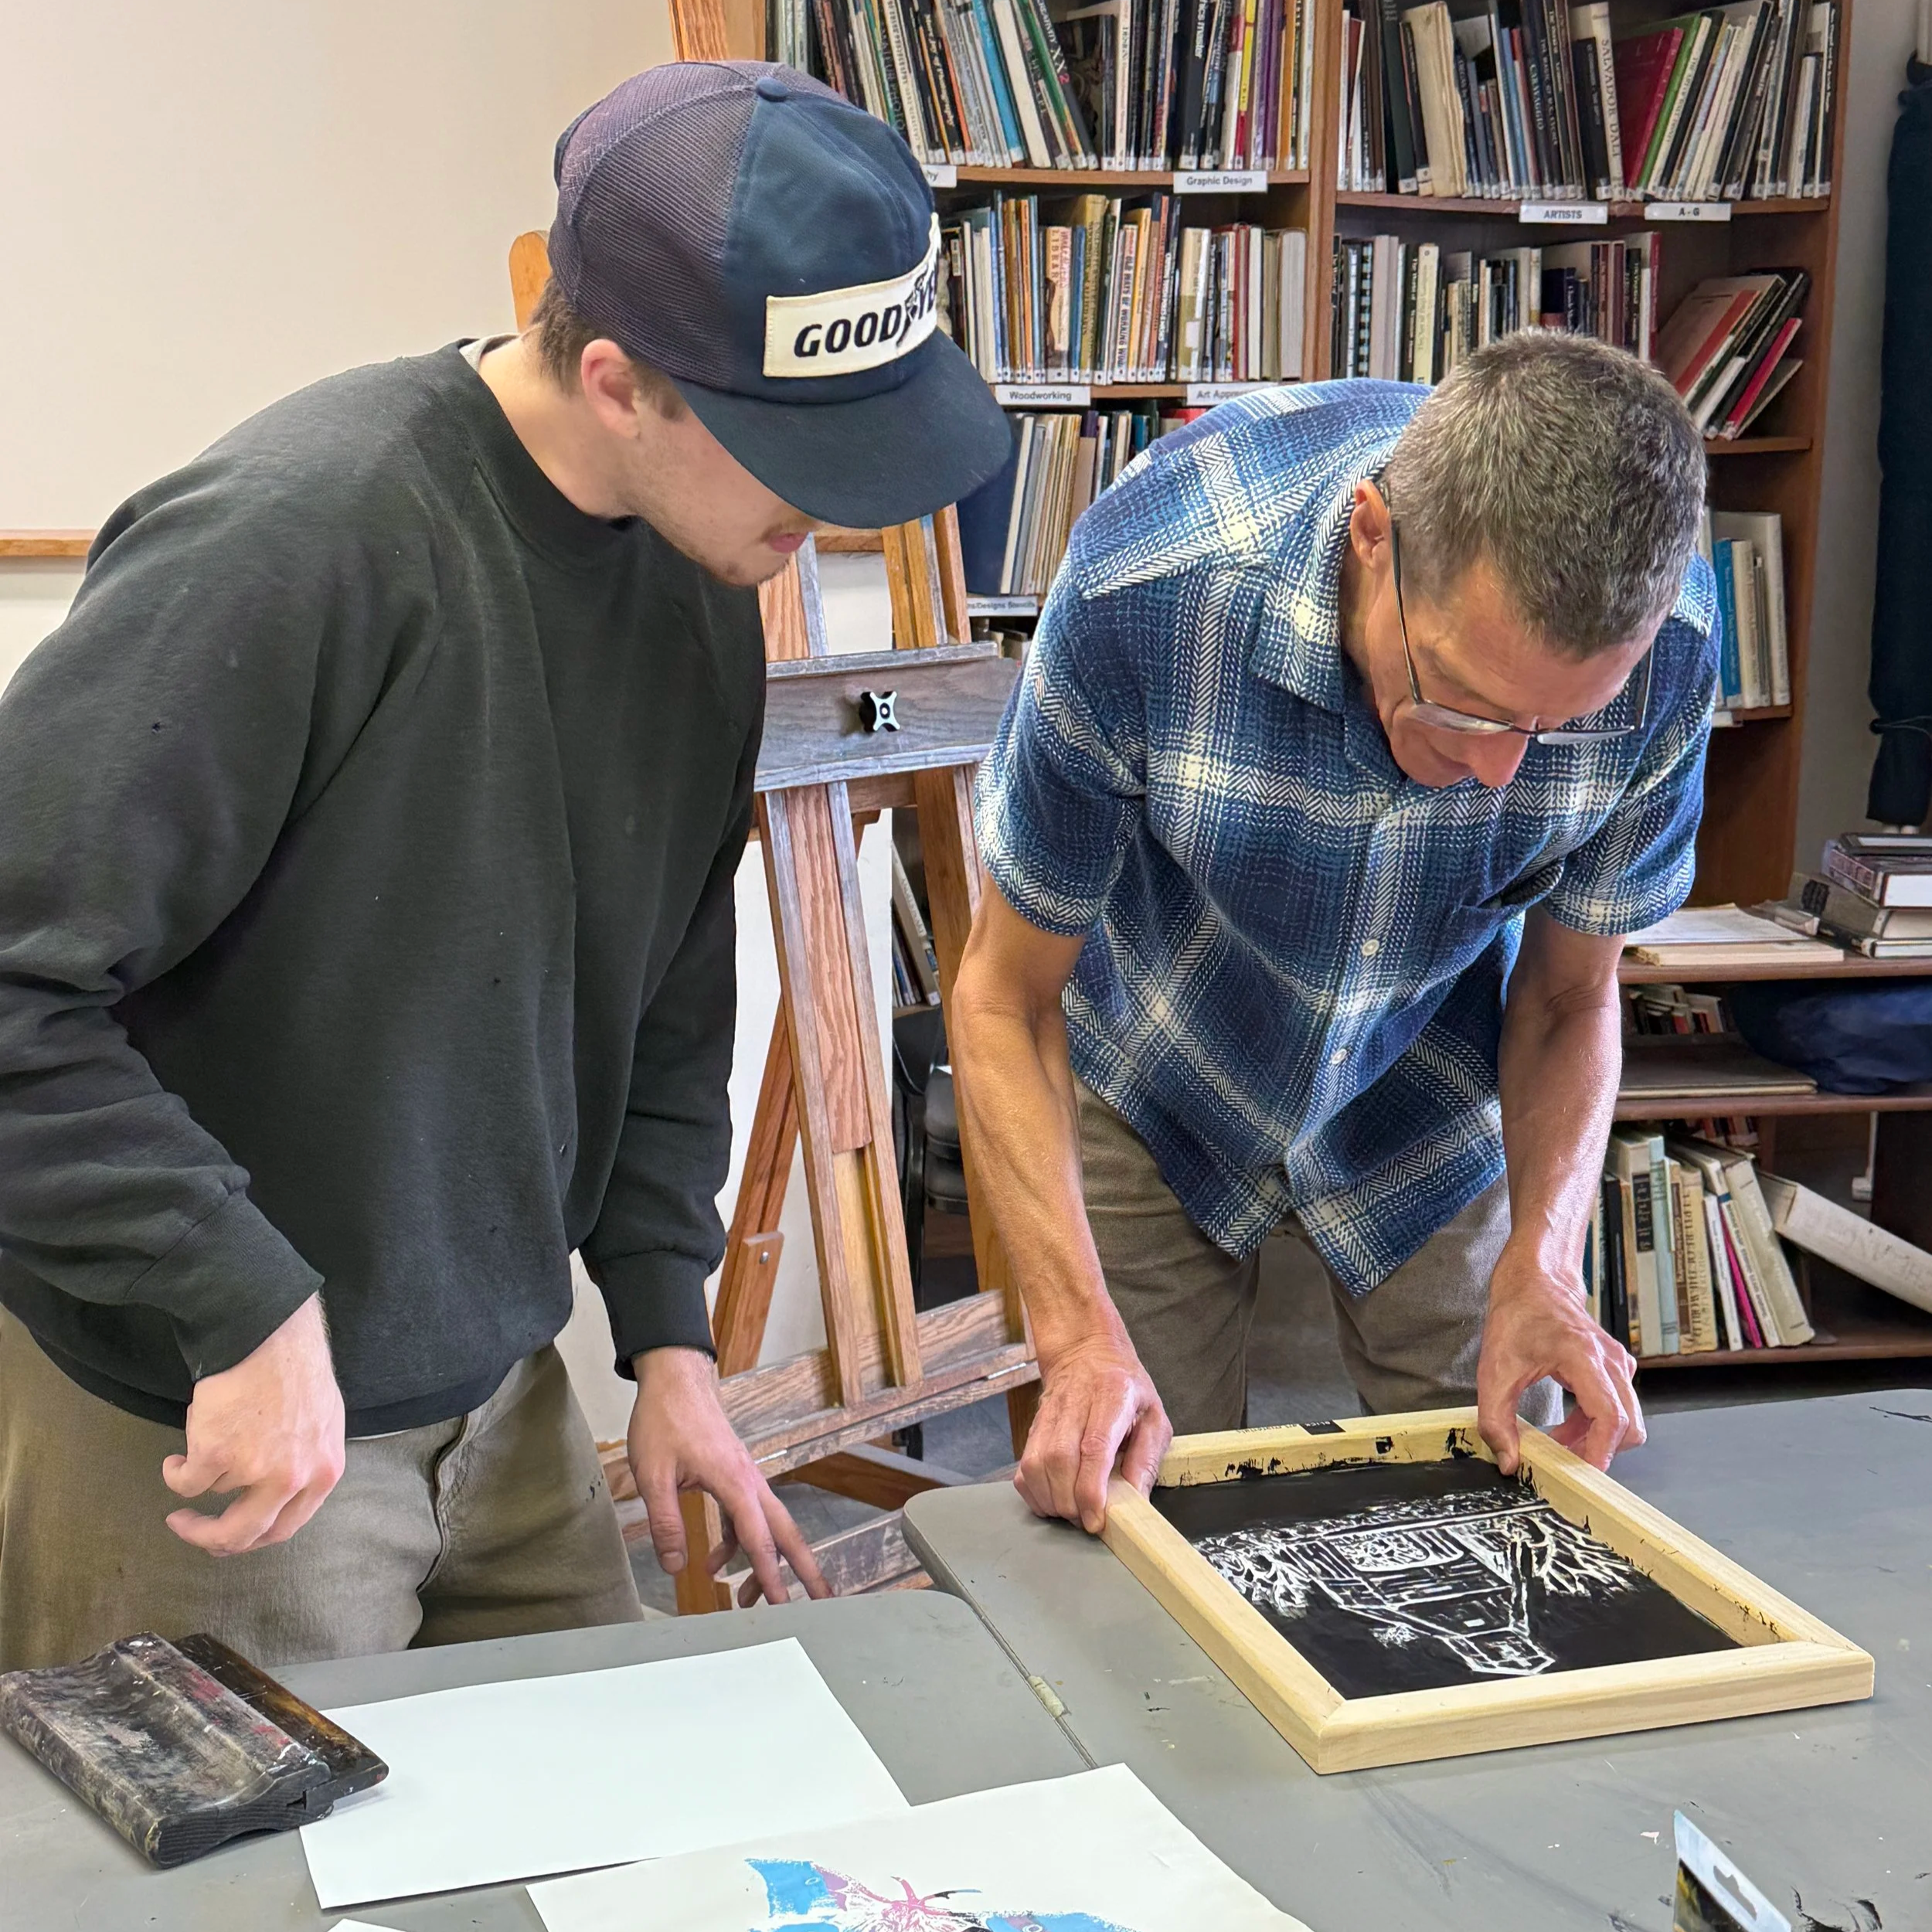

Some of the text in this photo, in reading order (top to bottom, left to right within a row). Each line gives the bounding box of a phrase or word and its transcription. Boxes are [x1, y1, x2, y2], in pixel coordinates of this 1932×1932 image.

[1193, 22, 1206, 59] master
[1528, 63, 1544, 130] CARAVAGGIO
[1599, 39, 1620, 157] SALVADOR DALI
[1186, 176, 1252, 187] Graphic Design
[1544, 209, 1582, 219] ARTISTS
[1678, 208, 1687, 216] A
[1692, 208, 1699, 216] G
[1009, 390, 1072, 401] Woodworking
[1197, 389, 1211, 399] Art
